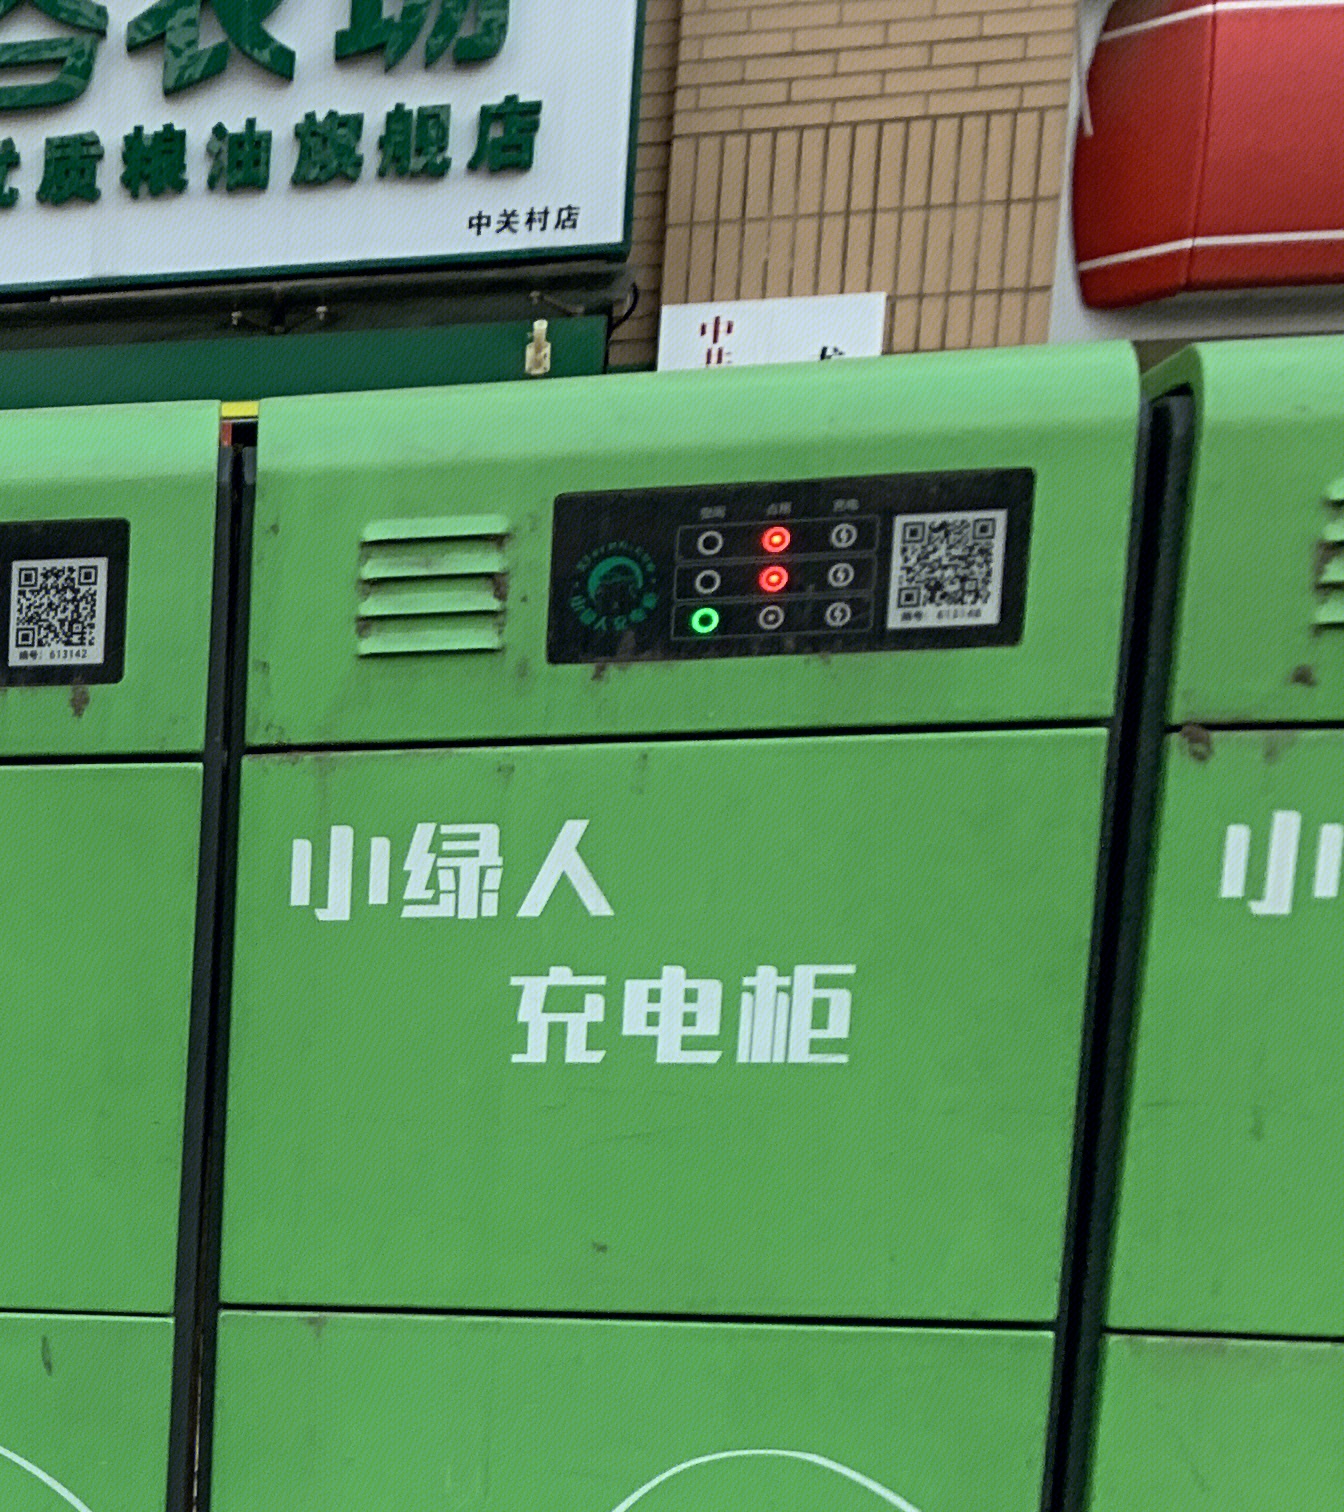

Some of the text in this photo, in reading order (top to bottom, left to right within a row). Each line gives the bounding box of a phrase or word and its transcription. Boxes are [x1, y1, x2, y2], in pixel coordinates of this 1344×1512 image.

[467, 204, 581, 237] 中关村店
[290, 819, 615, 922] 小绿人
[509, 964, 857, 1064] 充电柜
